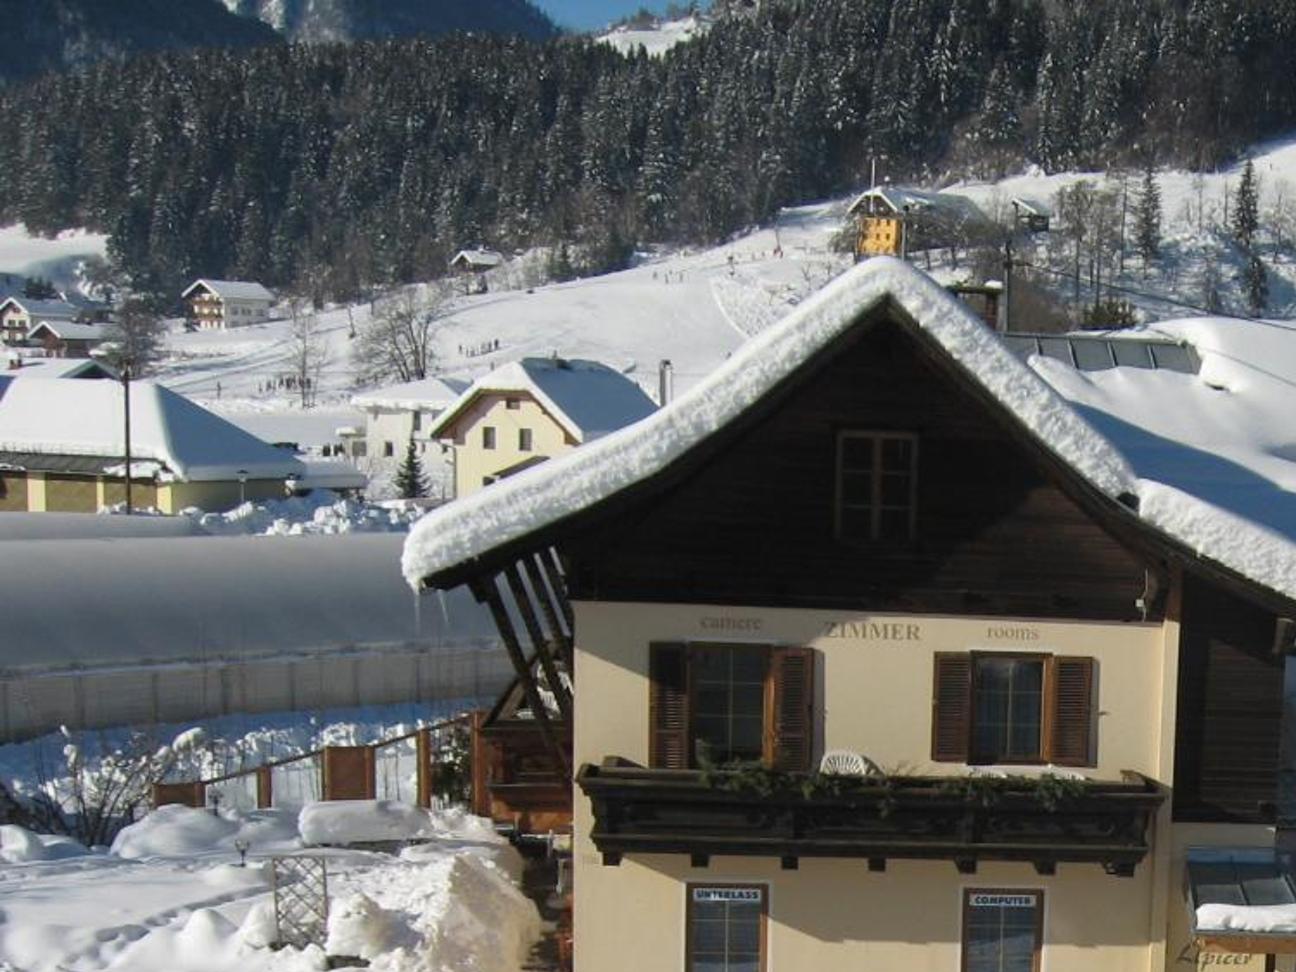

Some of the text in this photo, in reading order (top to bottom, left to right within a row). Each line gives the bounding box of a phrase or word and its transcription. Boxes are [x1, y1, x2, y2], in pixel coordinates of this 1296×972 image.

[825, 621, 921, 640] ZIMMER
[986, 627, 1041, 641] rooms
[695, 889, 759, 900] UNTERLASS
[974, 896, 1031, 905] COMPUTER
